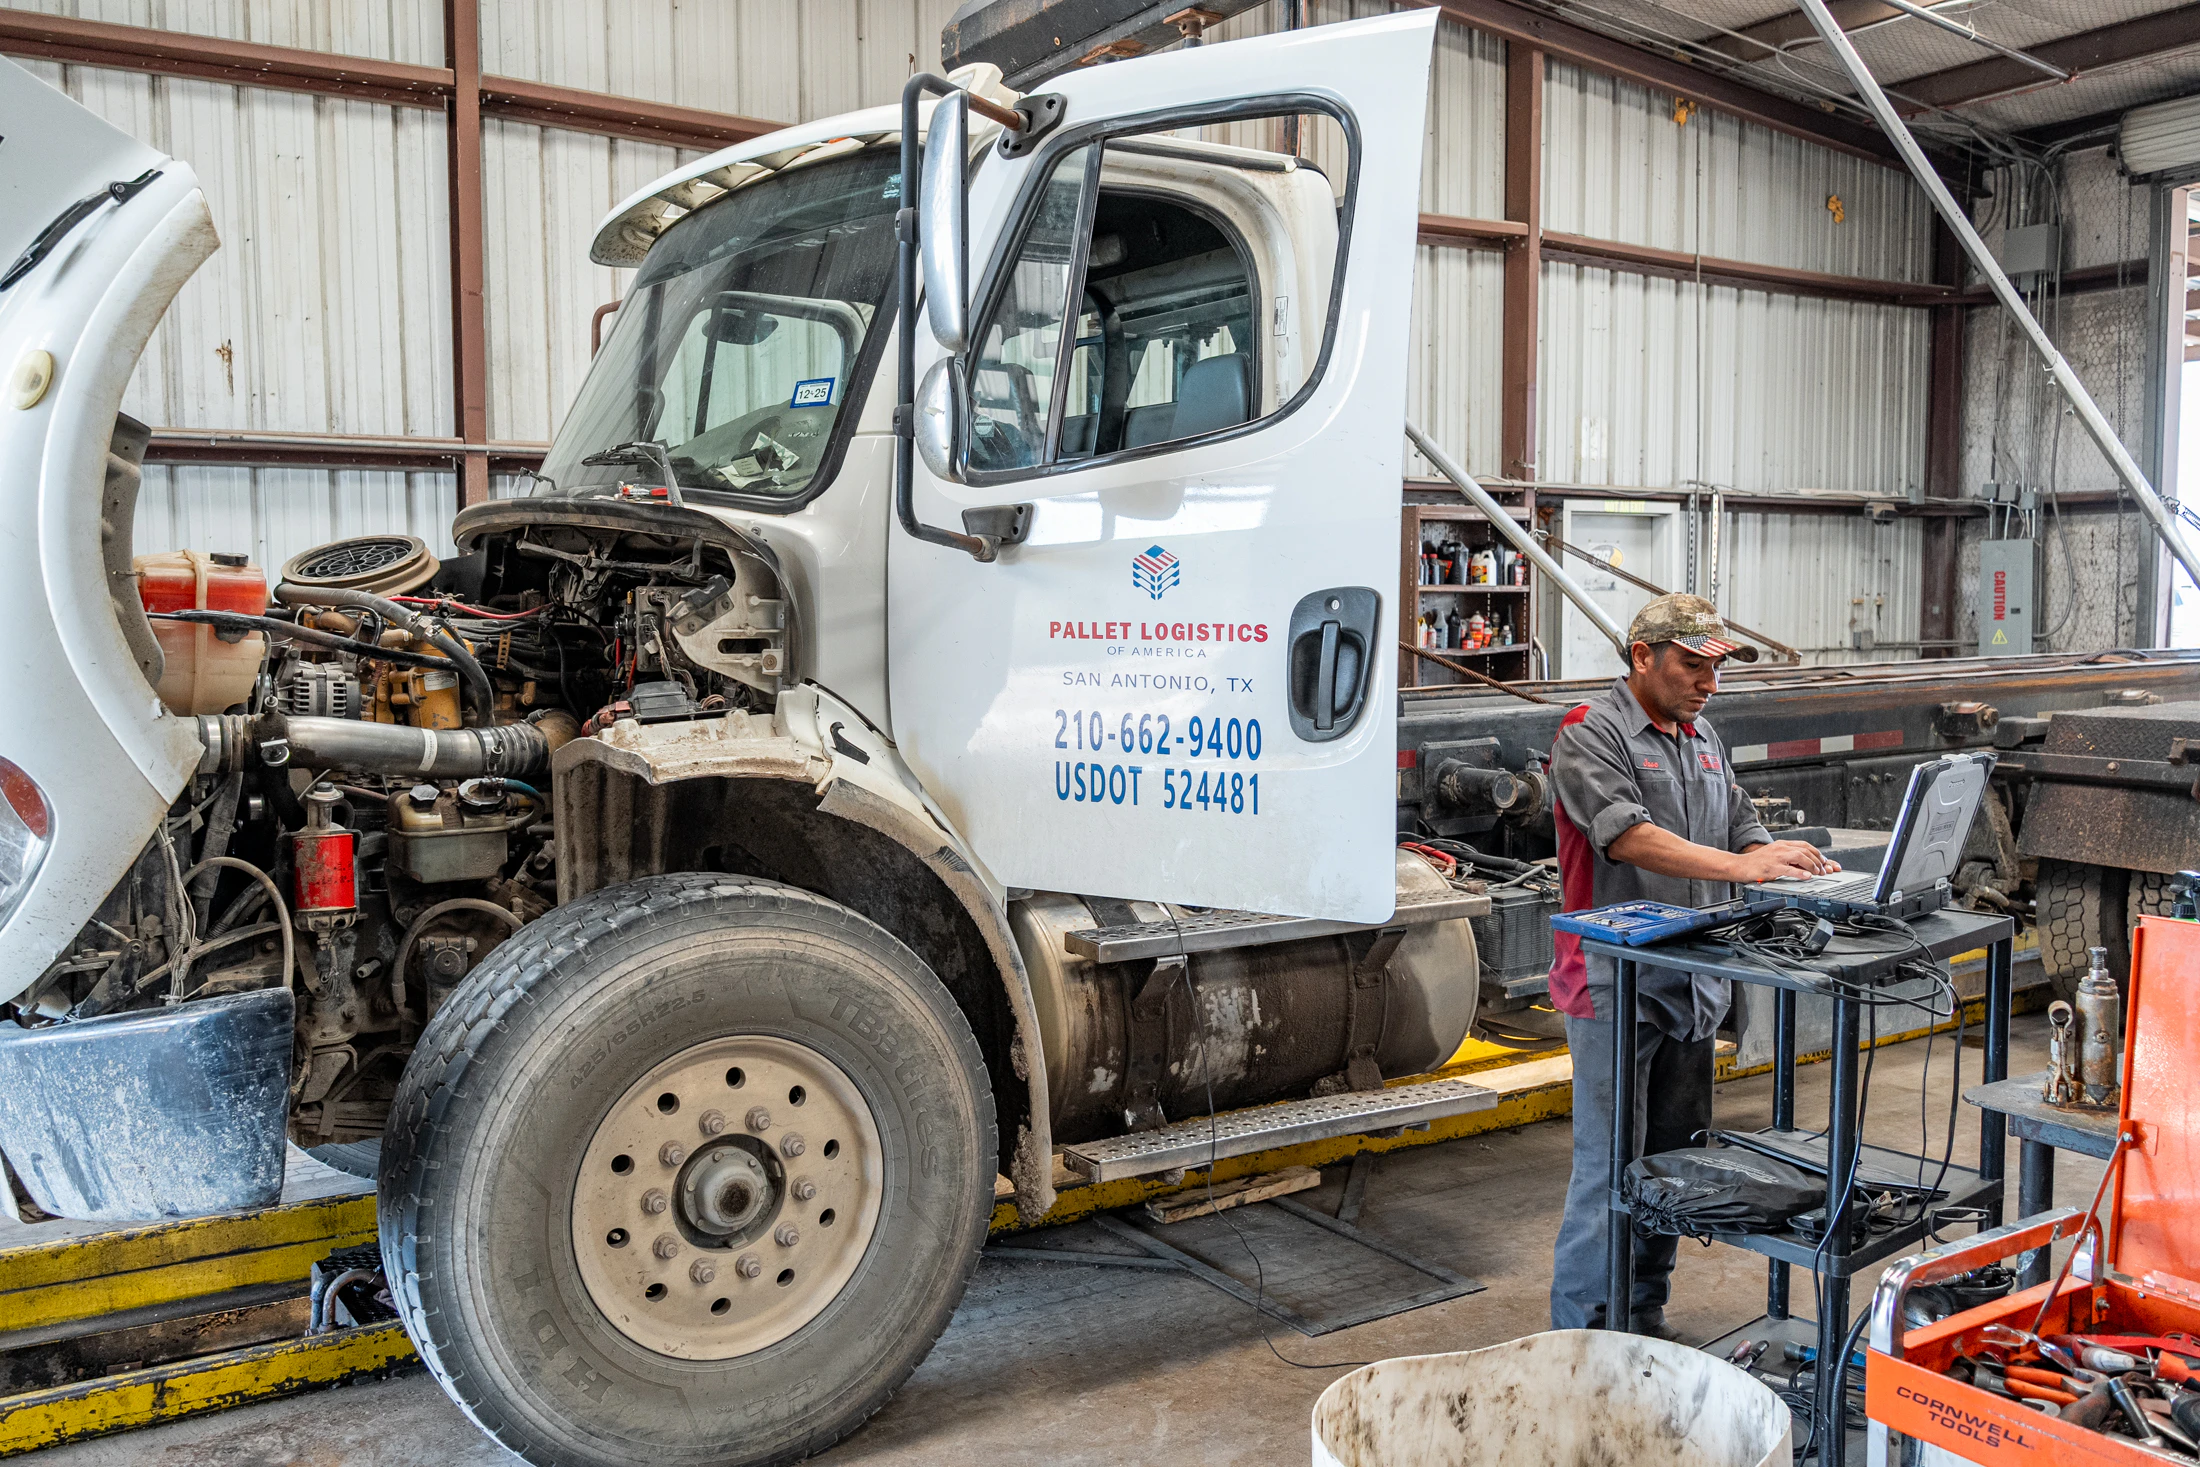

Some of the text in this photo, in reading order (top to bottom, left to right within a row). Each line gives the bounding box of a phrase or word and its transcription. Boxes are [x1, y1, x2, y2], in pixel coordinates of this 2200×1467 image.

[1993, 570, 2006, 620] CAUTION
[1049, 621, 1269, 643] PALLET LOGISTICS
[1106, 646, 1207, 658] OF AMERICA
[1062, 671, 1254, 694] SAN ANTONIO, TX
[1054, 708, 1262, 761] 210-662-9400
[1055, 760, 1259, 815] USDOT 524481
[1896, 1386, 2030, 1449] CORNWELL
[1928, 1411, 2001, 1448] TOOLS
